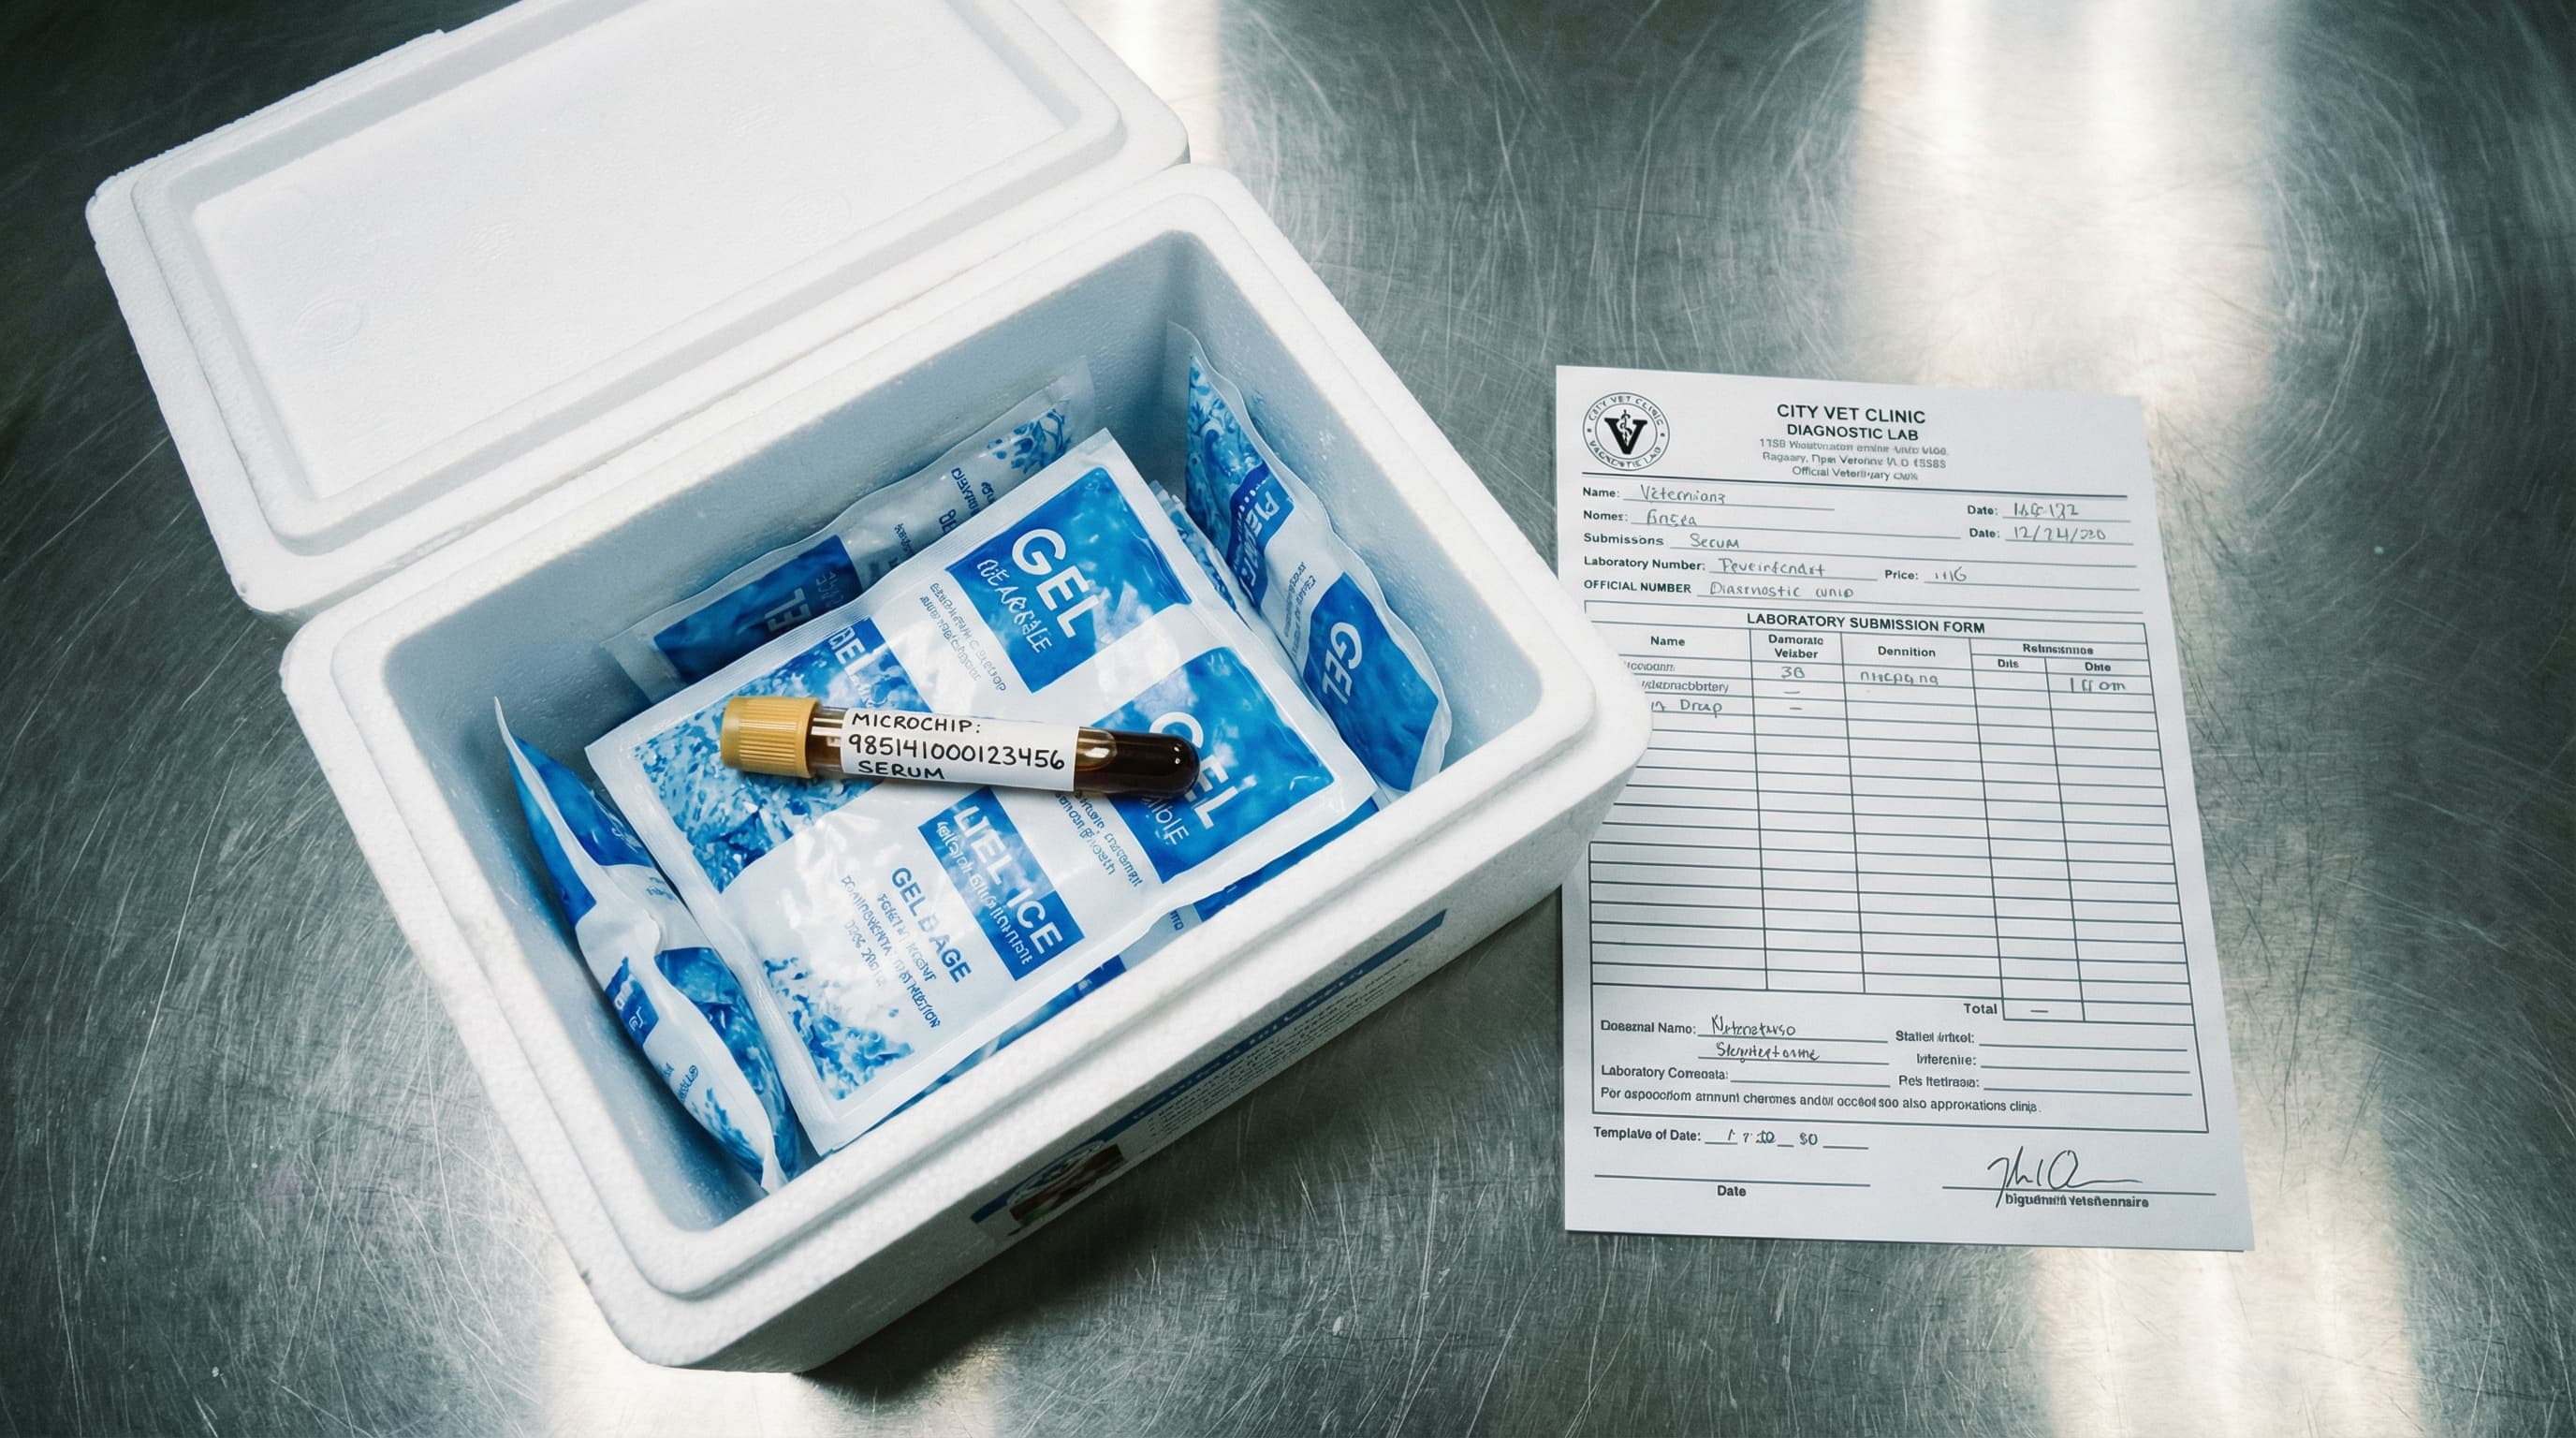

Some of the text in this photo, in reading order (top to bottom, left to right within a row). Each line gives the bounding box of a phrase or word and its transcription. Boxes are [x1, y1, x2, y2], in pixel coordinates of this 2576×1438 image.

[1777, 404, 1926, 424] CITY VET CLINIC
[1787, 424, 1919, 442] DIAGNOSTIC LAB
[1583, 487, 1619, 498] Name:
[1967, 506, 1998, 516] Date:
[1969, 528, 2000, 538] Date:
[1584, 556, 1705, 571] Laboratory Number:
[1885, 569, 1918, 580] Price:
[1012, 528, 1099, 638] GEL
[1584, 580, 1691, 594] OFFICIAL NUMBER
[1747, 613, 1985, 634] LABORATORY SUBMISSION FORM
[1650, 636, 1685, 647] Name
[1323, 622, 1363, 704] GEL
[852, 712, 982, 734] MICROCHIP:
[847, 733, 1065, 771] 985141000123456
[857, 759, 945, 780] SERUM
[892, 868, 928, 917] GEL
[1008, 888, 1062, 954] ICE
[1963, 1004, 1998, 1015] Total
[1601, 1064, 1665, 1080] Laboratory
[1902, 1098, 1927, 1109] also
[1655, 1128, 1668, 1140] of
[1671, 1129, 1702, 1141] Date:
[1717, 1185, 1747, 1196] Date
